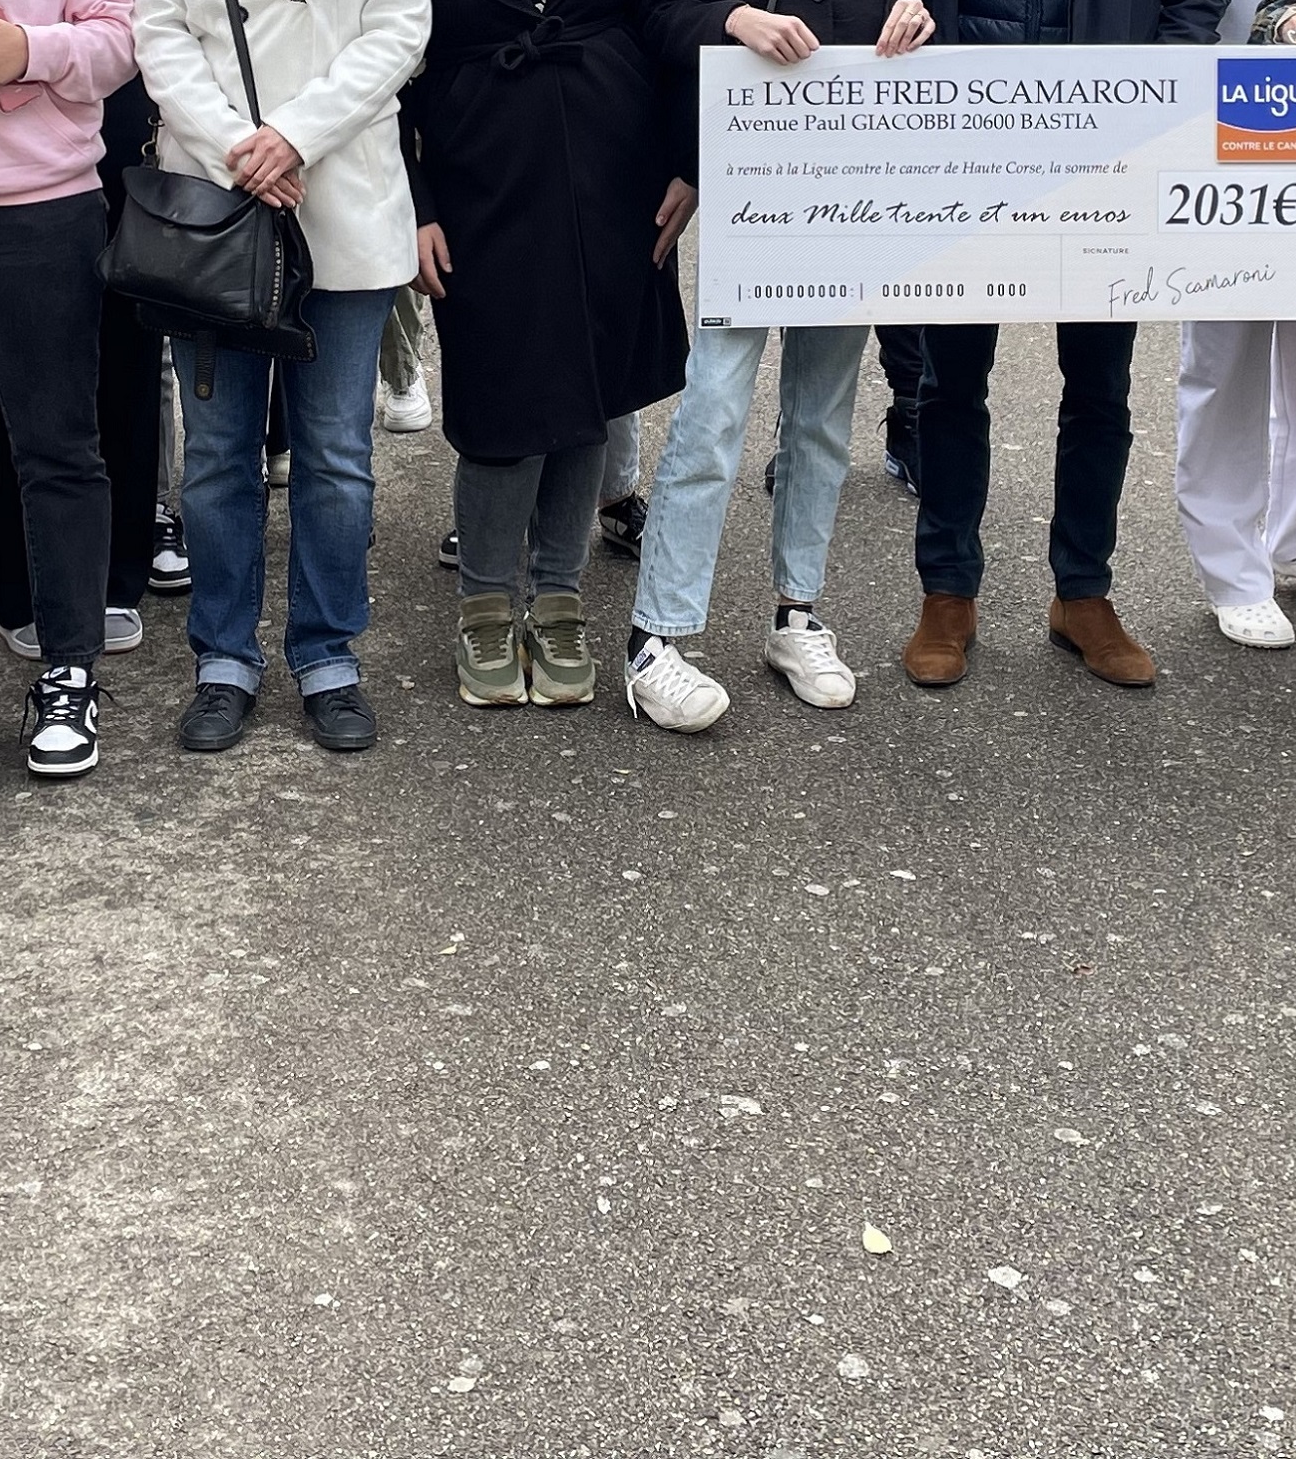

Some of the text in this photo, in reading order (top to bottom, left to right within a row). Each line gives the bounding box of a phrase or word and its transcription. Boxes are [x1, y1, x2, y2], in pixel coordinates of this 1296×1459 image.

[727, 75, 1178, 106] LE LYCÉE FRED SCAMARONI
[1221, 84, 1248, 103] LA
[727, 113, 1099, 132] Avenue Paul GIACOBBI 20600 BASTIA
[1222, 141, 1262, 151] CONTRE
[1263, 141, 1274, 151] LE
[726, 161, 1128, 179] à remis à la Ligue contre le cancer de Haute Corse, la somme de
[731, 199, 1132, 225] deux Mille trente et un euros
[882, 284, 965, 297] 00000000
[986, 283, 1027, 297] 0000
[1108, 263, 1277, 318] Fred Scamaroni
